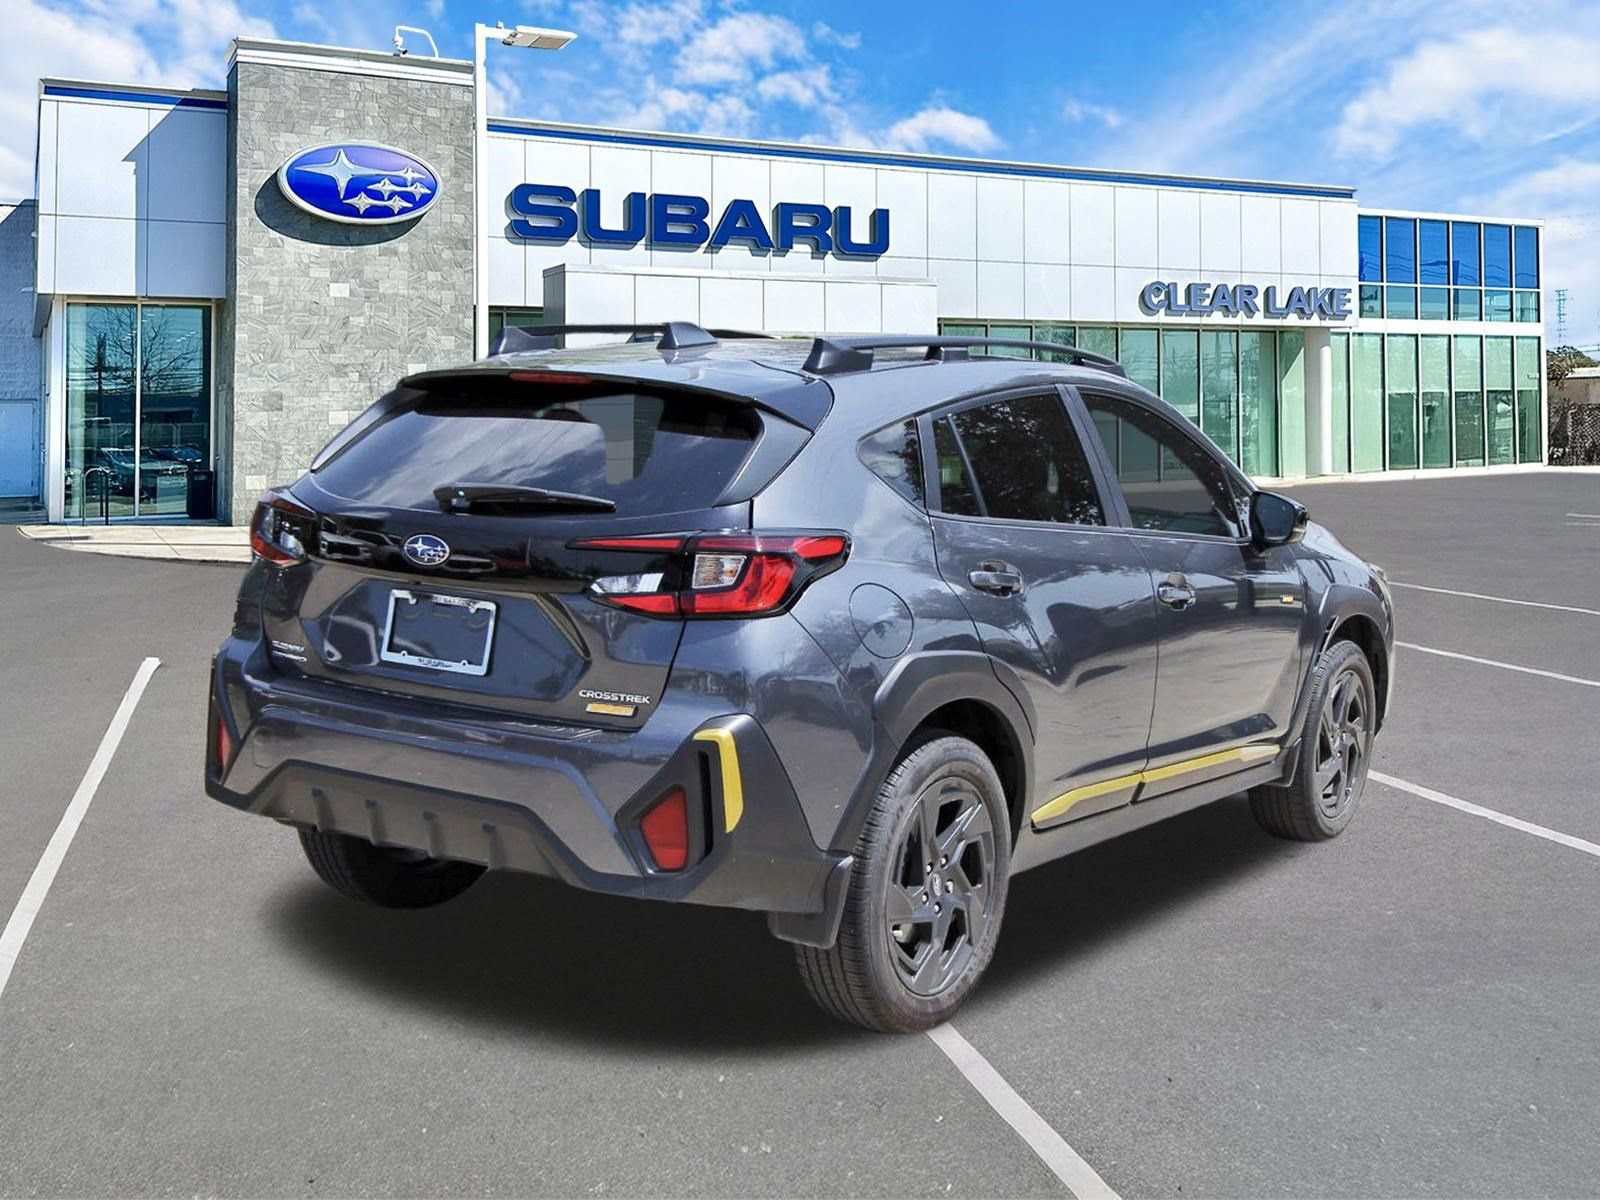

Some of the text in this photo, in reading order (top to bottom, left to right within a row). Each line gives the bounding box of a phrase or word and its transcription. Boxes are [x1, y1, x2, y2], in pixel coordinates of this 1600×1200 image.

[506, 183, 890, 257] SUBARU
[1141, 281, 1353, 317] CLEAR LAKE
[578, 689, 651, 704] CROSSTREK
